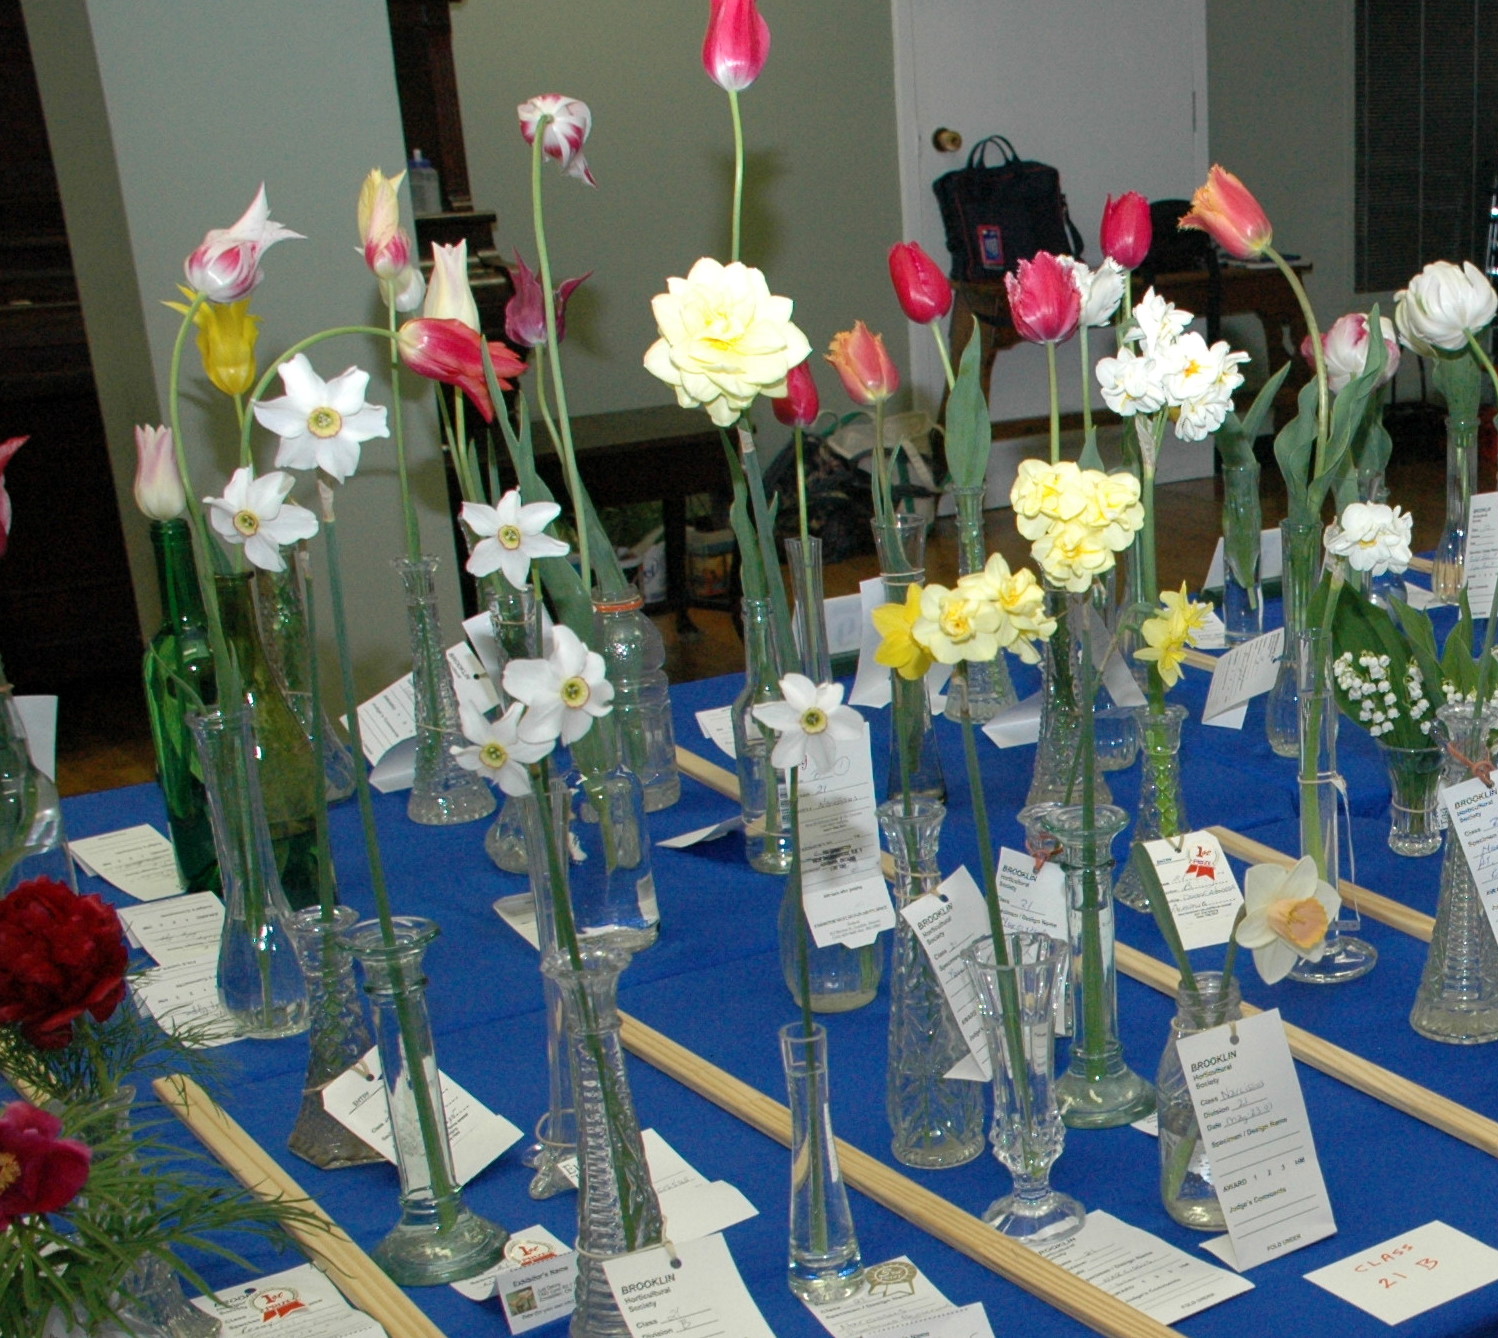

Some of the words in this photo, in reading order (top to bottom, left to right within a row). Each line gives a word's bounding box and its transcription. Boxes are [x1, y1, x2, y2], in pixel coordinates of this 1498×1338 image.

[1454, 788, 1498, 810] BROOKLIN
[1002, 865, 1038, 881] BROOKLIN
[917, 903, 953, 930] BROOKLIN
[926, 931, 945, 946] Society
[1190, 1050, 1237, 1073] BROOKLIN
[1193, 1064, 1232, 1081] Horticultural
[1195, 1077, 1220, 1090] Society
[1200, 1096, 1219, 1106] Class
[1203, 1105, 1230, 1119] Division
[1207, 1121, 1222, 1132] Date
[1211, 1132, 1243, 1148] Specimen
[1247, 1124, 1269, 1138] Design
[1270, 1117, 1288, 1129] Name
[1223, 1178, 1248, 1193] AWARD
[1229, 1198, 1253, 1214] Judge's
[1254, 1186, 1287, 1204] Comments
[1266, 1240, 1282, 1252] FOLD
[1283, 1234, 1302, 1247] UNDER
[513, 1272, 548, 1287] Exhibitor's
[549, 1266, 569, 1275] Name
[621, 1273, 676, 1295] BROOKLIN
[1378, 1271, 1408, 1289] 21
[624, 1286, 671, 1304] Horticultural
[629, 1300, 657, 1313] Society
[636, 1318, 658, 1329] Class
